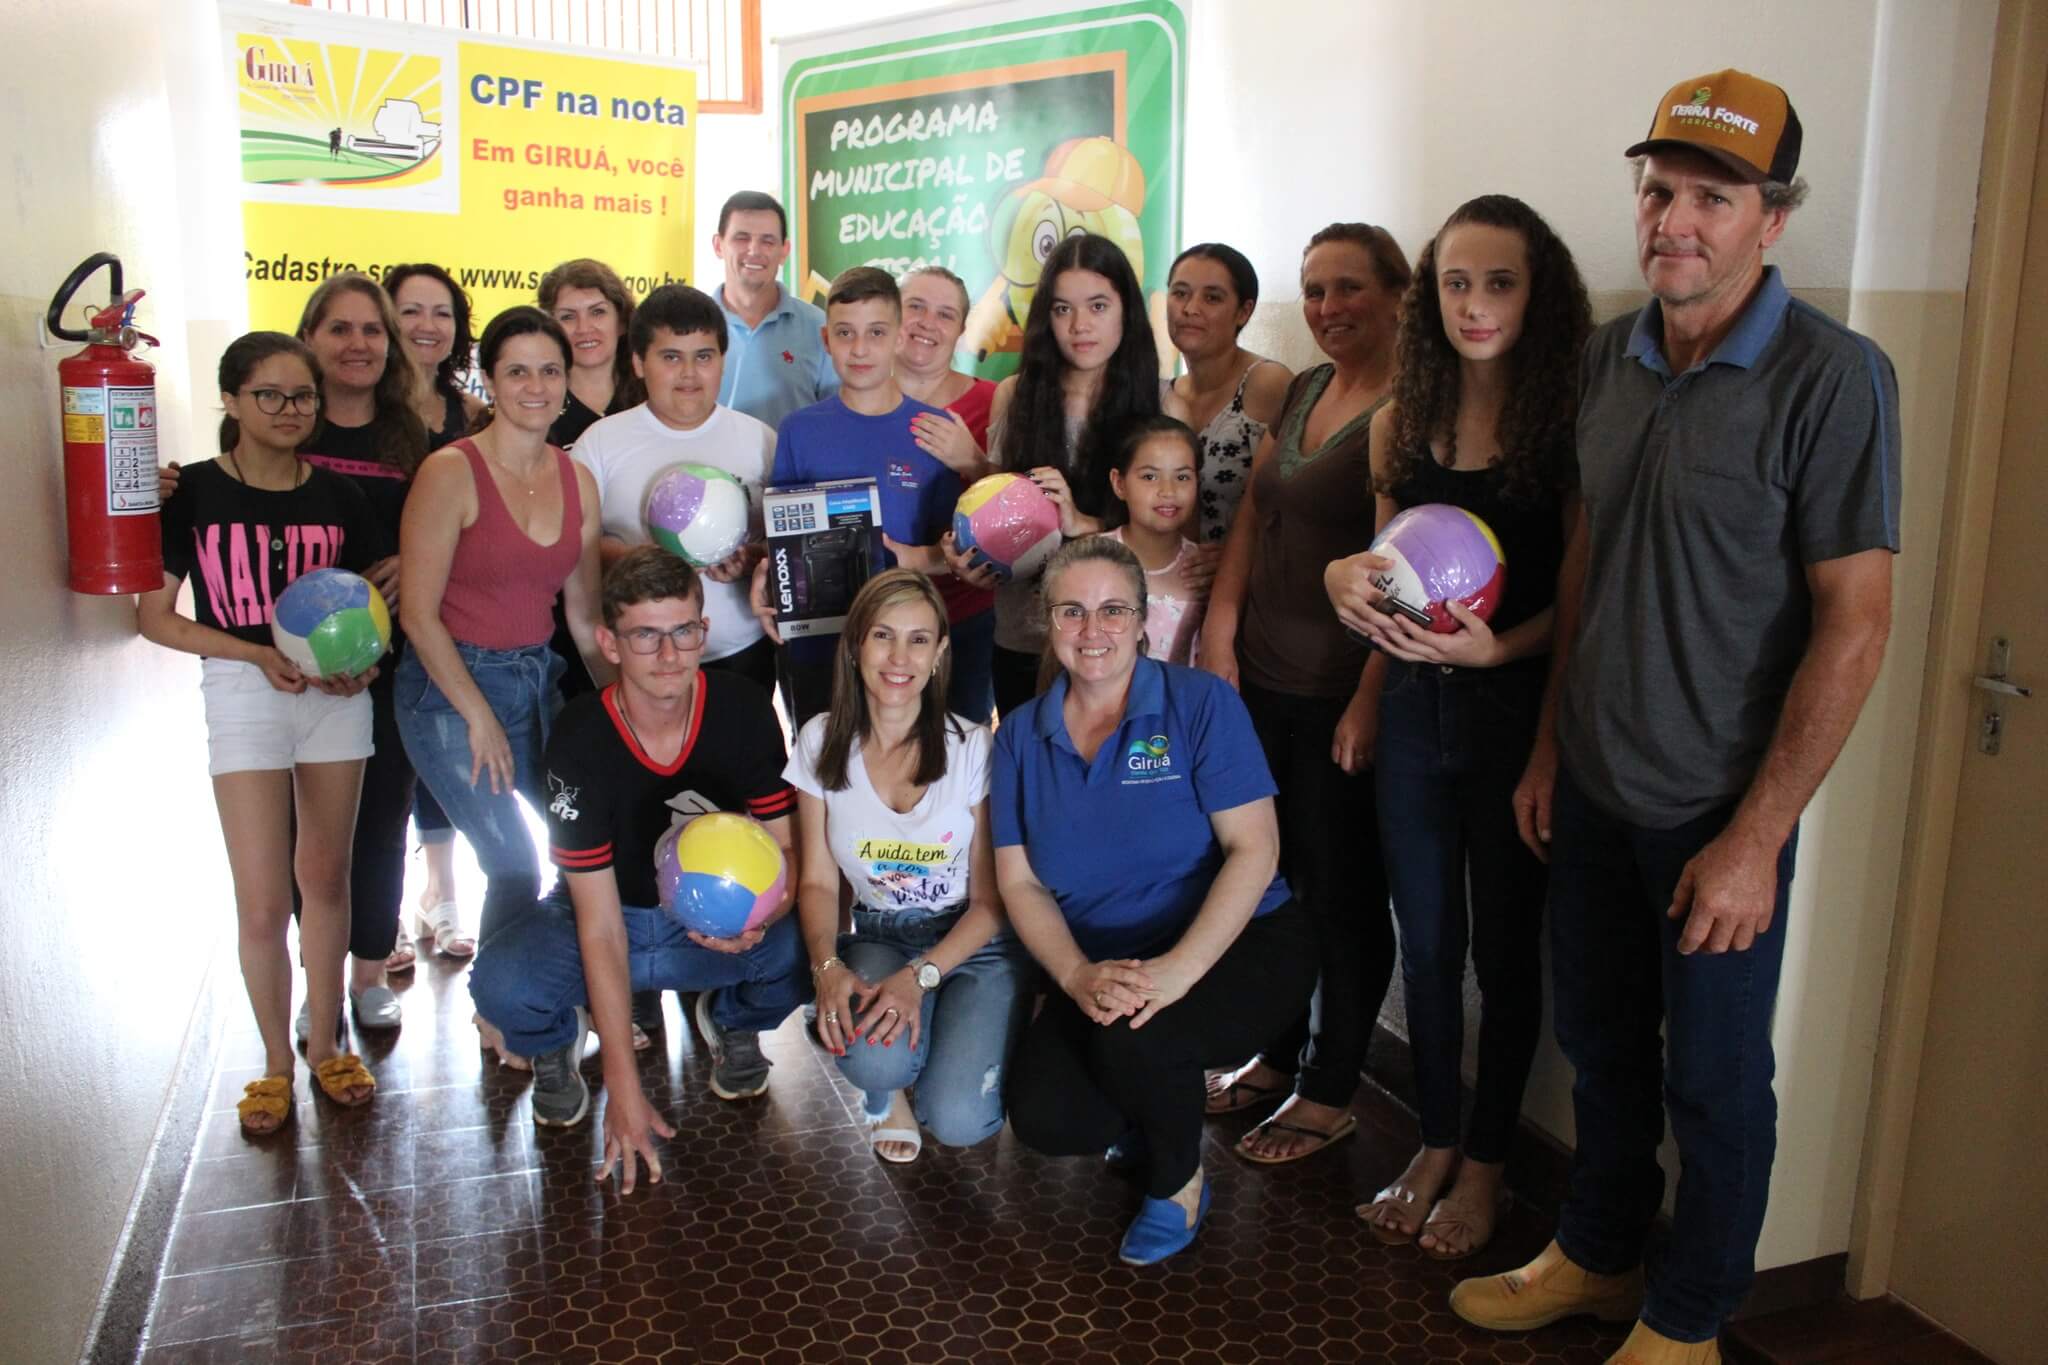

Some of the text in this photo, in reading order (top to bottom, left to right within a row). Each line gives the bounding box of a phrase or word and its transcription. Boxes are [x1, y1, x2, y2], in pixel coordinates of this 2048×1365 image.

[470, 73, 686, 126] CPF na nota
[1670, 104, 1760, 135] TERRA FORTE
[830, 100, 1000, 152] PROGRAMA
[472, 138, 685, 178] Em GIRUÁ, você
[810, 148, 1025, 200] MUNICIPAL DE
[503, 187, 585, 211] ganha
[594, 194, 653, 214] mais
[839, 194, 989, 250] EDUCAÇÃO
[860, 841, 947, 862] A vida tem
[877, 862, 927, 874] a cor
